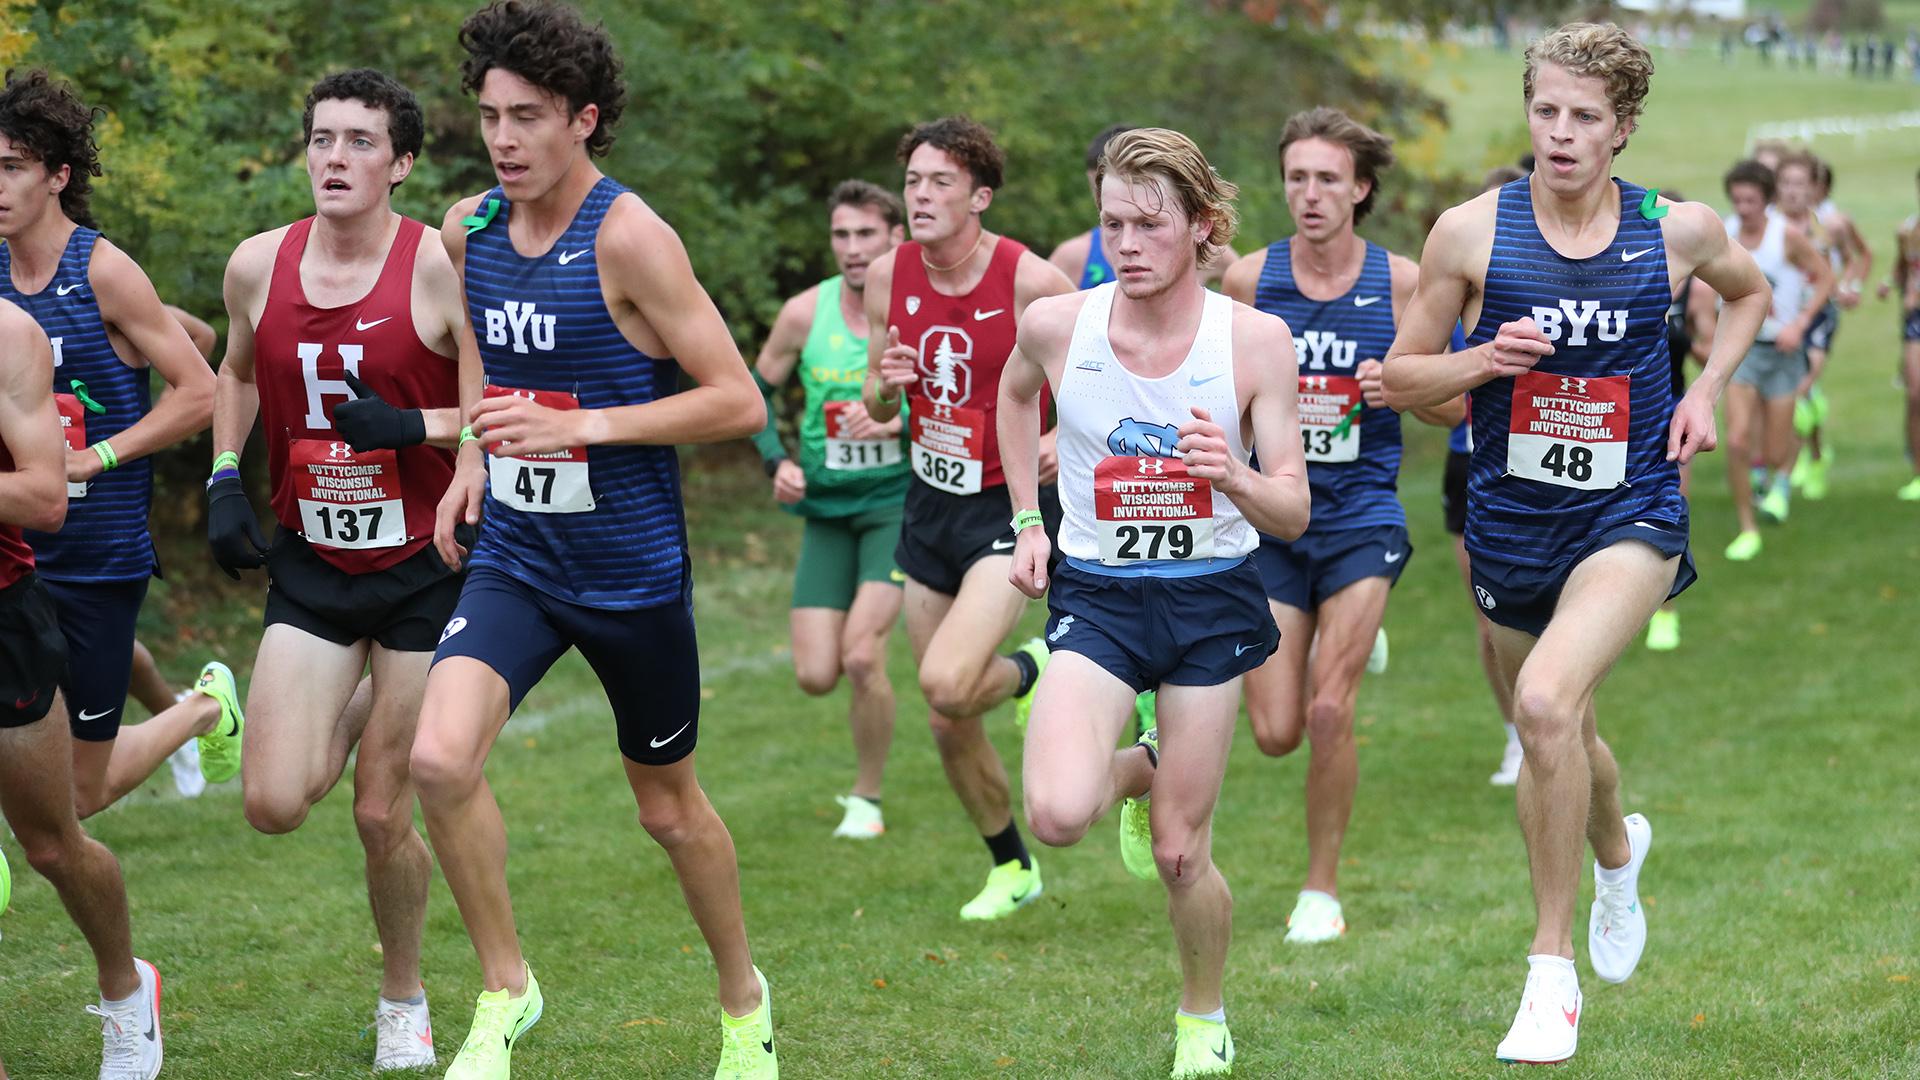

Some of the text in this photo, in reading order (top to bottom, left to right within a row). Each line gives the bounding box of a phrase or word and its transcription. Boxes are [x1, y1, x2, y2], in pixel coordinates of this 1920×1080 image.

[485, 300, 557, 354] BYU
[1531, 298, 1629, 347] BYU
[1293, 330, 1358, 370] BYU
[297, 342, 364, 430] H
[1531, 396, 1616, 414] NUTTYCOMBE
[1539, 409, 1604, 427] WISCONSIN
[1529, 420, 1614, 440] INVITATIONAL
[839, 444, 883, 464] 311
[1540, 443, 1594, 482] 48
[308, 464, 383, 477] NUTTYCOMBE
[921, 452, 966, 488] 362
[316, 476, 374, 488] WISCONSIN
[514, 466, 557, 504] 47
[1112, 481, 1195, 493] NUTTYCOMBE
[311, 487, 387, 501] INVITATIONAL
[1120, 493, 1184, 505] WISCONSIN
[1112, 505, 1197, 519] INVITATIONAL
[316, 506, 383, 542] 137
[1115, 524, 1194, 559] 279
